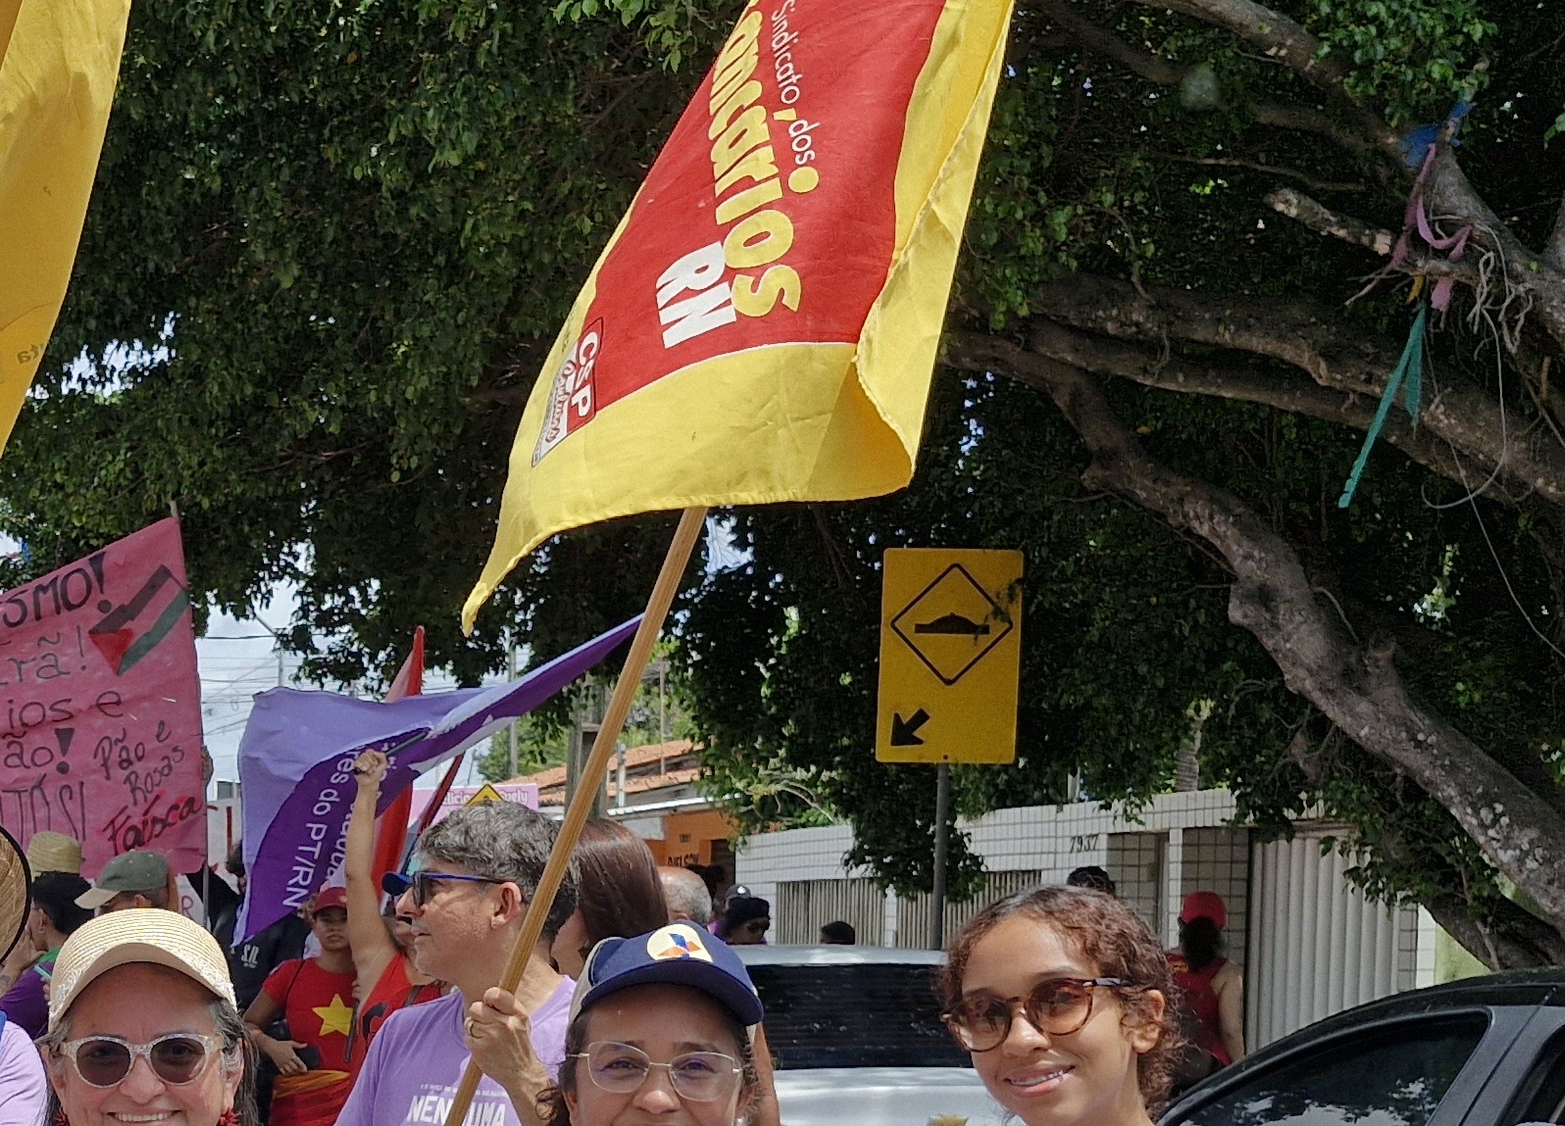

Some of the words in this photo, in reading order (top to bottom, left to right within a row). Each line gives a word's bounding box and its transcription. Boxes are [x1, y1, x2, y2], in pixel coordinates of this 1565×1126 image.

[771, 0, 803, 104] Sindicato
[788, 118, 821, 165] dos
[708, 2, 820, 318] ancários
[656, 241, 737, 349] RN
[572, 331, 599, 418] CSP
[95, 689, 125, 719] e
[93, 727, 146, 781] Pão
[122, 745, 186, 807] Rosas
[101, 792, 204, 858] Faísca
[312, 787, 342, 817] do
[282, 821, 329, 909] PT/RN
